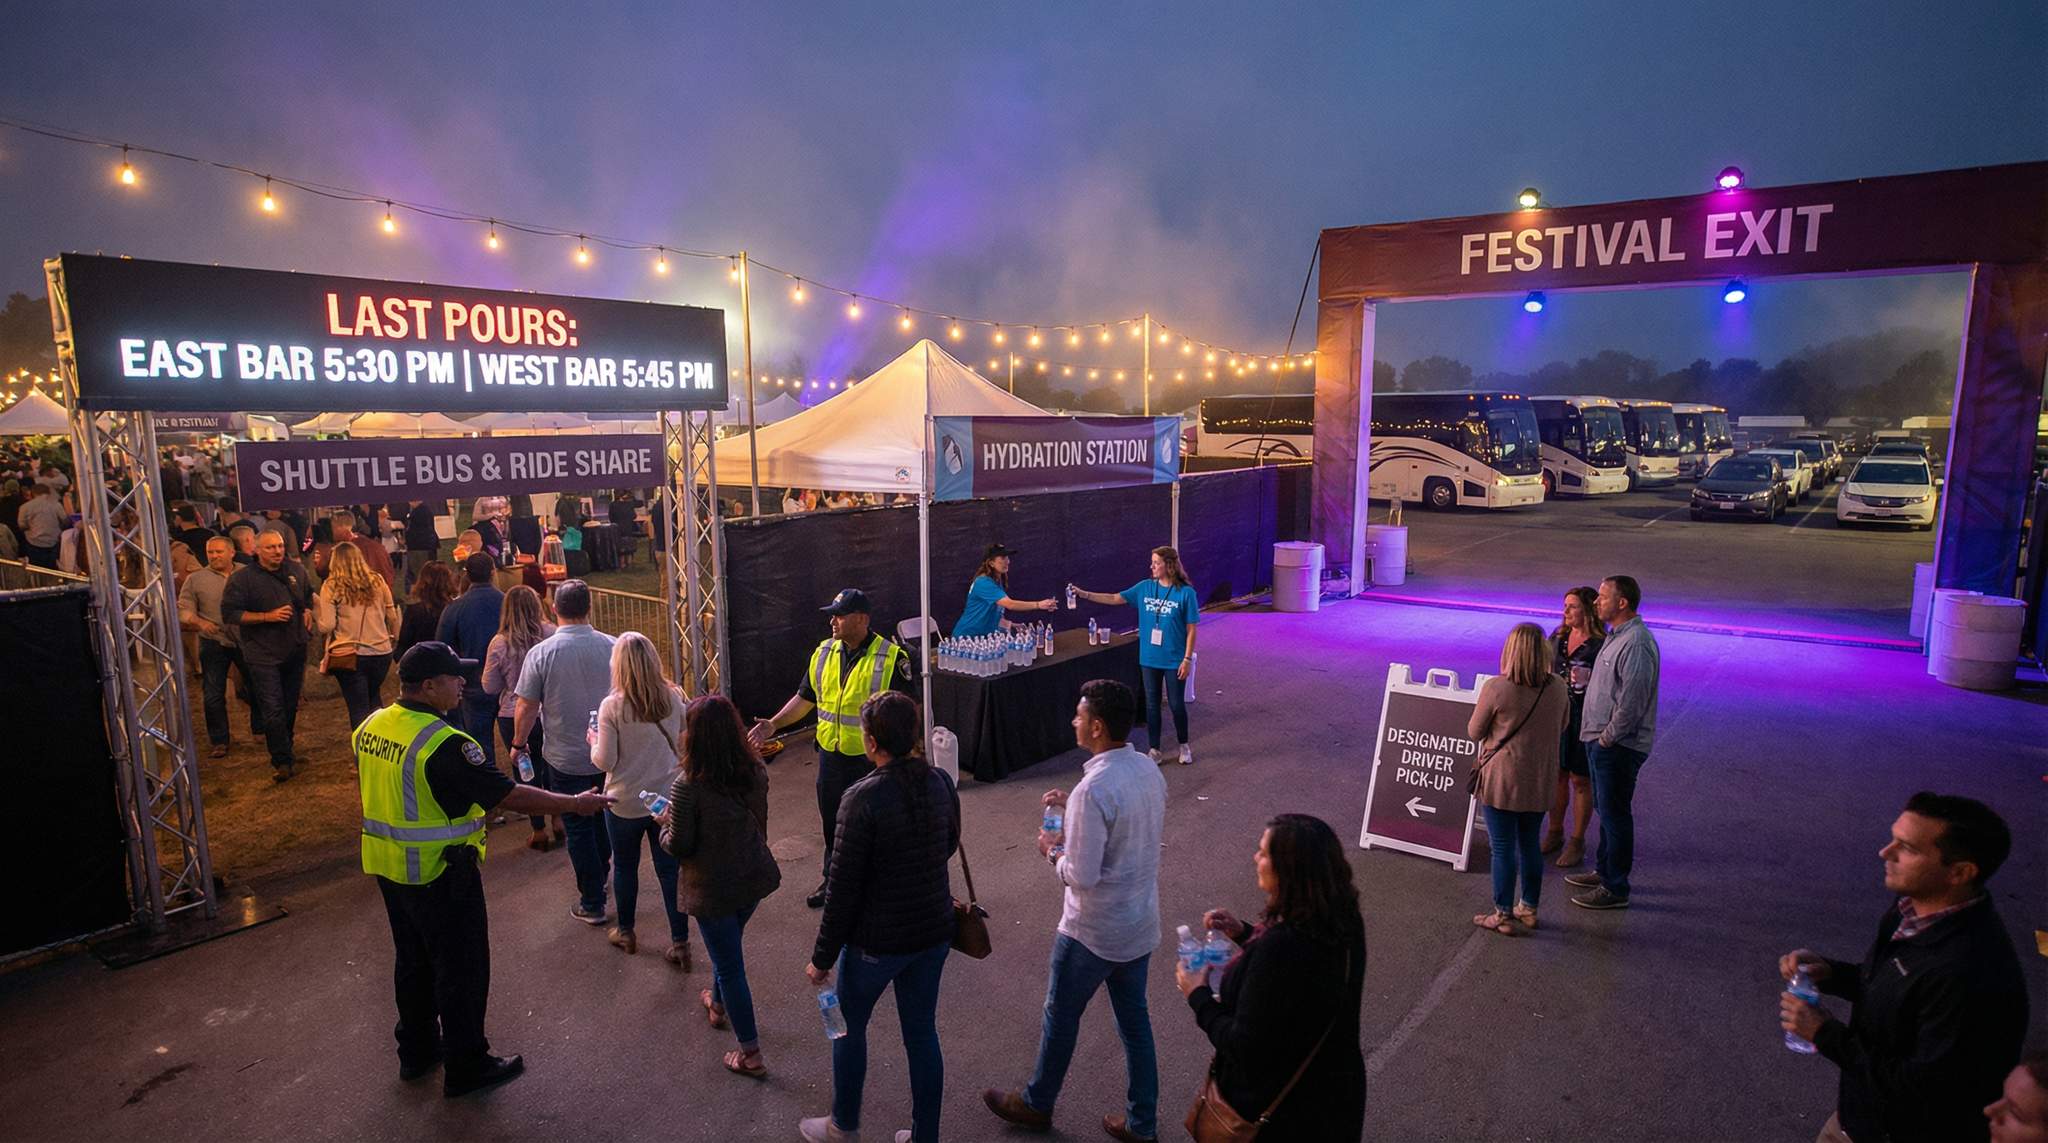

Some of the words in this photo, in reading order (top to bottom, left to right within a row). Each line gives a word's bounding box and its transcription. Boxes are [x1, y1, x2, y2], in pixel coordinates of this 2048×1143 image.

[1460, 217, 1686, 275] FESTIVAL
[1704, 204, 1834, 260] EXIT
[327, 293, 433, 340] LAST
[443, 301, 578, 347] POURS:
[120, 338, 227, 378] EAST
[237, 343, 316, 381] BAR
[324, 347, 398, 383] 5:30
[405, 350, 455, 384] PM
[478, 352, 559, 386] WEST
[565, 356, 617, 387] BAR
[622, 359, 674, 388] 5:45
[679, 361, 714, 389] PM
[260, 456, 407, 492] SHUTTLE
[414, 454, 474, 484] BUS
[481, 453, 503, 481] &
[509, 451, 569, 480] RIDE
[574, 449, 652, 477] SHARE
[983, 441, 1081, 470] HYDRATION
[1086, 439, 1148, 465] STATION
[360, 731, 407, 765] SECURITY
[1387, 727, 1475, 755] DESIGNATED
[1401, 749, 1454, 773] DRIVER
[1395, 767, 1455, 792] PICK-UP
